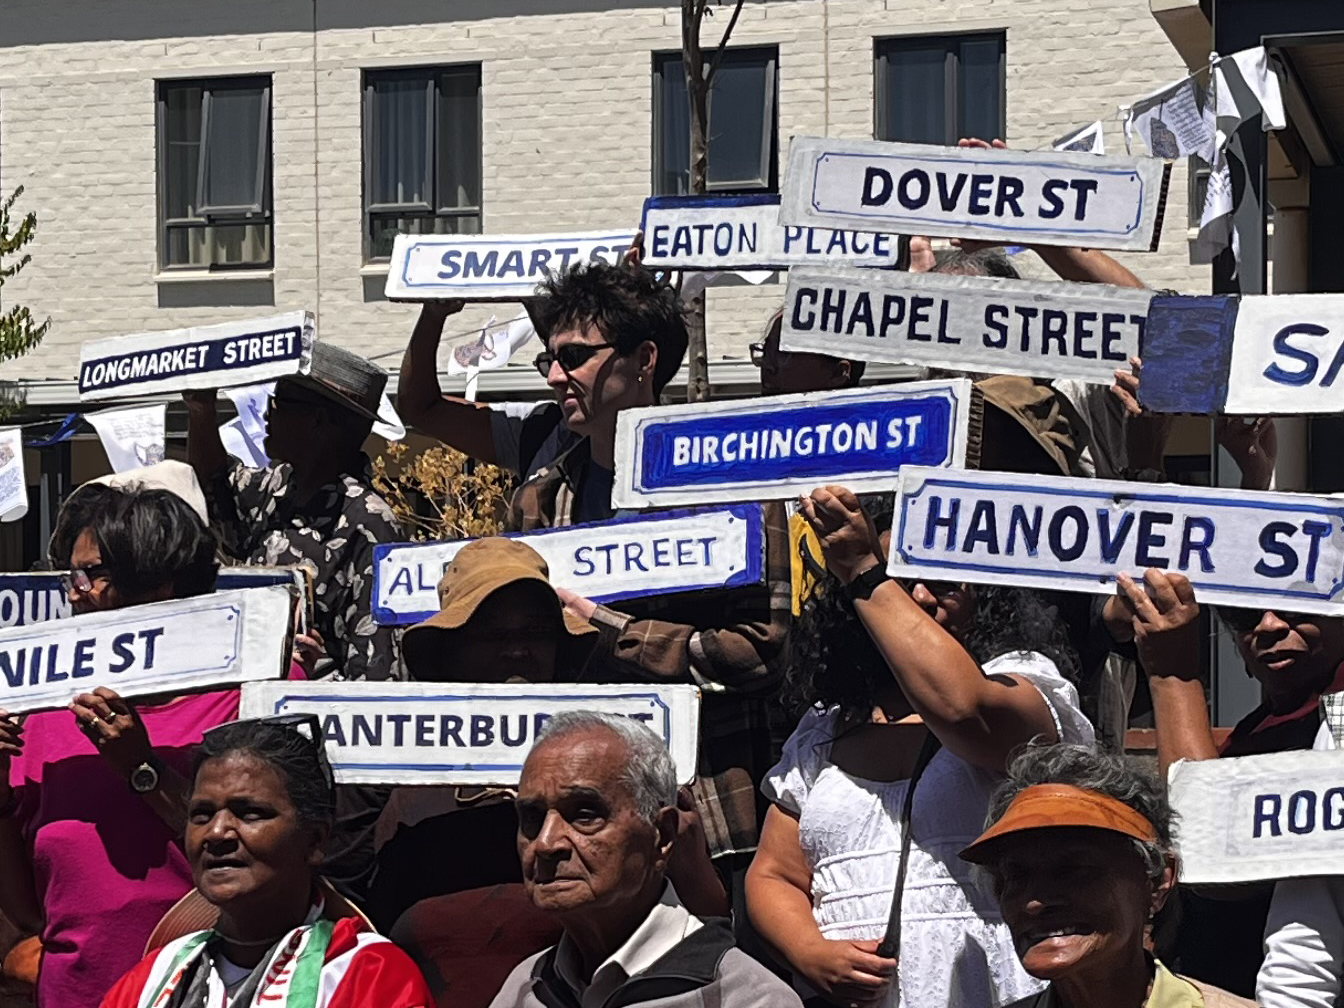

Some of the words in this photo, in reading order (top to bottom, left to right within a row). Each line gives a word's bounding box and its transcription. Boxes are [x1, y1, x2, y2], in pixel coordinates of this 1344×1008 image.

[861, 166, 1024, 217] DOVER
[1038, 177, 1098, 221] ST
[437, 247, 578, 280] SMART
[652, 222, 757, 258] EATON
[784, 225, 890, 256] PLACE
[790, 286, 970, 345] CHAPEL
[984, 304, 1148, 362] STREET
[82, 345, 209, 388] LONGMARKET
[222, 331, 297, 364] STREET
[672, 418, 878, 467] BIRCHINGTON
[886, 415, 923, 448] ST
[573, 536, 717, 577] STREET
[923, 495, 1217, 573] HANOVER
[1254, 520, 1333, 583] ST
[108, 627, 164, 674] ST
[322, 713, 554, 747] ANTERBU
